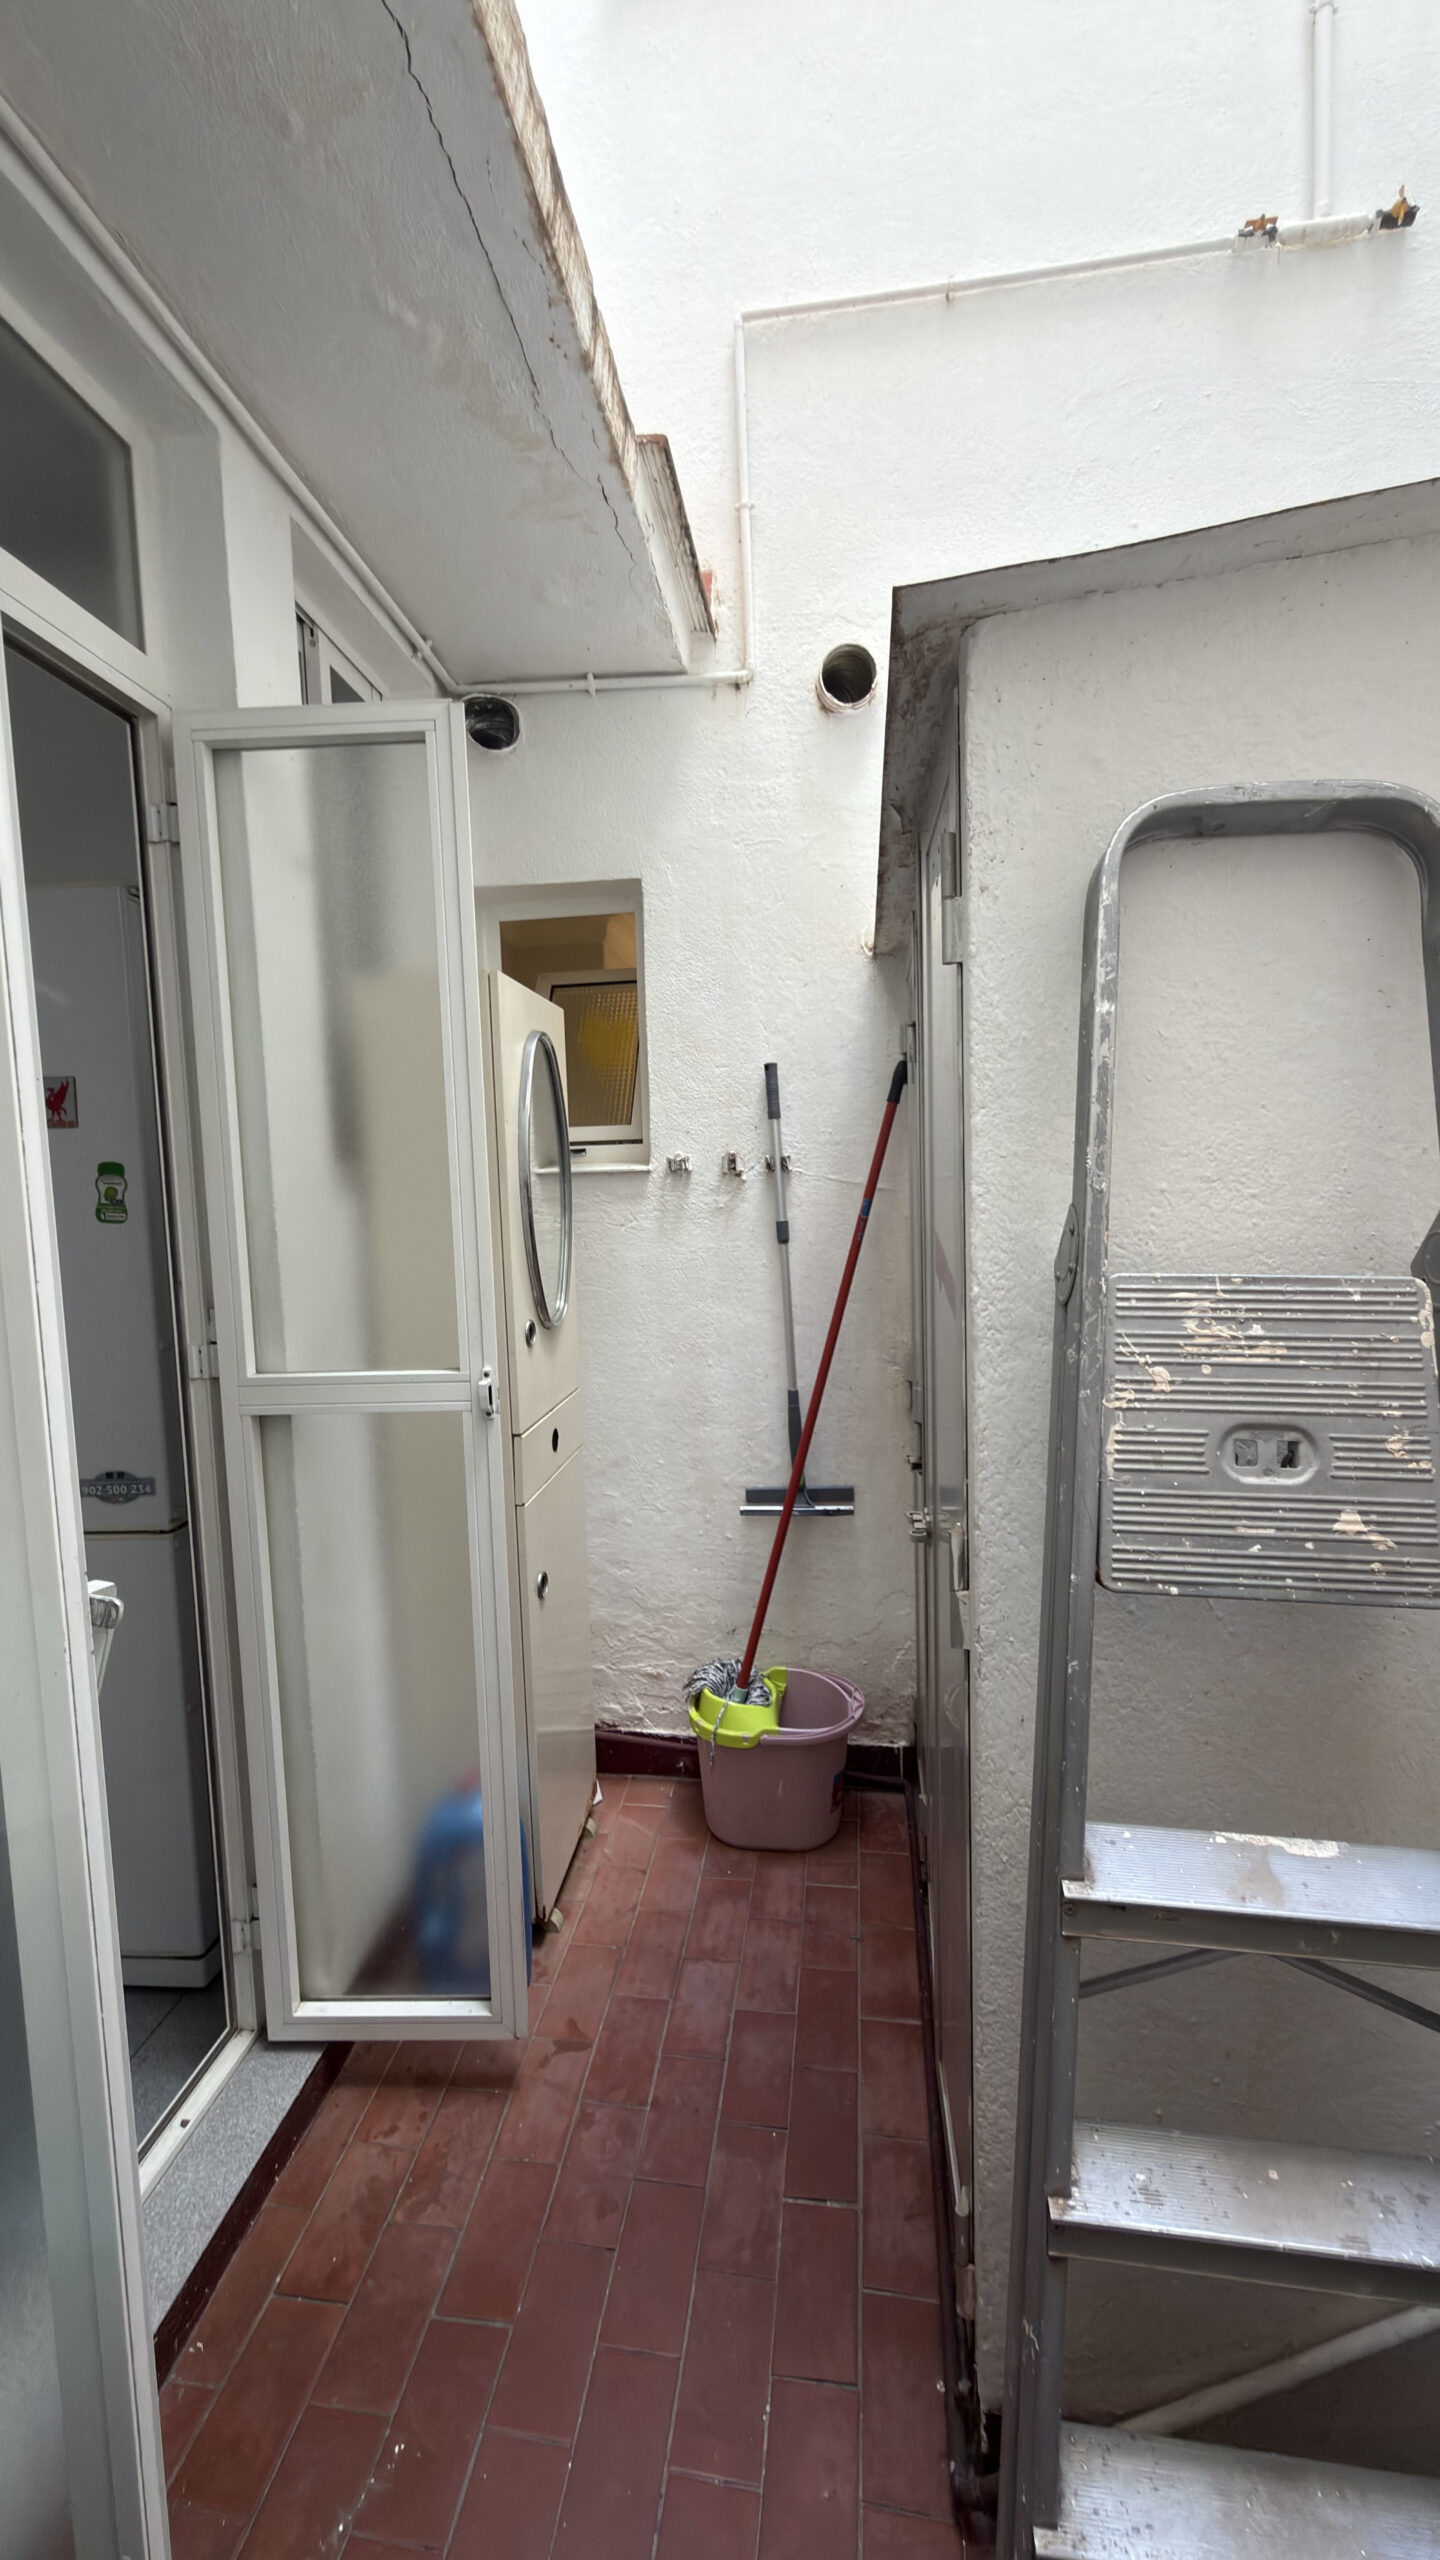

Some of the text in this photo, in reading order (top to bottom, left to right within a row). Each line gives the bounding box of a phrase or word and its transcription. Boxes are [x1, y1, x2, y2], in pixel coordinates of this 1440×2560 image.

[82, 1484, 151, 1495] 902 500 234
